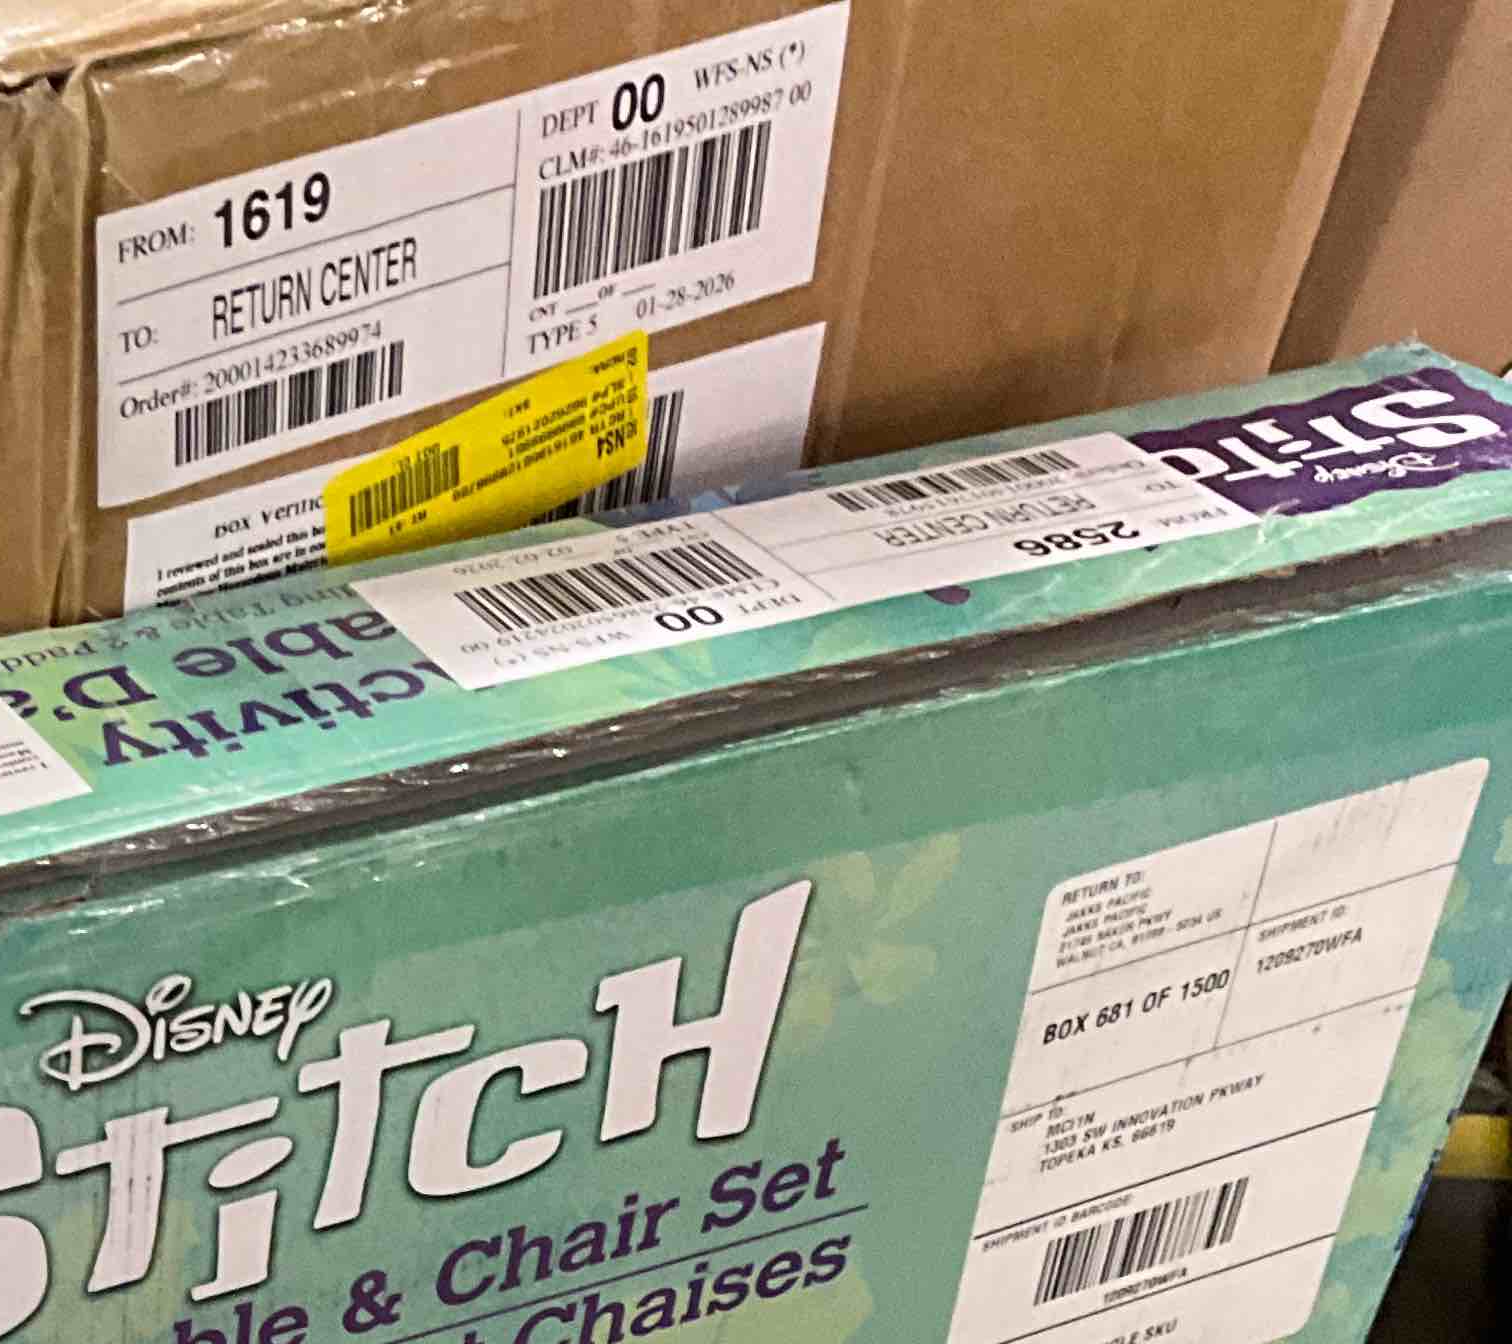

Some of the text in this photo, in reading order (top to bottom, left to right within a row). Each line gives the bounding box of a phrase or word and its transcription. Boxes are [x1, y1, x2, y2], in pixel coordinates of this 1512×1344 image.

[541, 100, 599, 139] DEPT
[611, 73, 665, 131] 00
[693, 47, 773, 90] WFS-NS
[117, 171, 331, 263] FROM: 1619
[121, 237, 418, 354] TO: RETURN CENTER
[526, 270, 736, 355] TYPE 5 01-28-2026
[120, 381, 199, 420] Order#:
[1160, 389, 1500, 484] Stitc
[261, 496, 325, 525] Verific
[873, 513, 989, 547] CENTER
[1013, 519, 1140, 557] 2586
[171, 600, 276, 632] Table
[654, 604, 724, 634] 00
[172, 610, 397, 677] able
[1061, 876, 1120, 906] RETURN
[1257, 911, 1330, 942] SHIPMENT
[1041, 967, 1232, 1047] BOX 681 OF 1500
[1009, 1113, 1044, 1134] SHIP
[1041, 1072, 1265, 1156] 1303 SW INNOVATION PKWAY
[1038, 1143, 1097, 1173] TOPEKA
[344, 1267, 406, 1331] &
[433, 1188, 681, 1309] Chair
[699, 1137, 849, 1236] Set
[981, 1222, 1050, 1252] SHIPMENT
[1143, 1317, 1180, 1343] SKU
